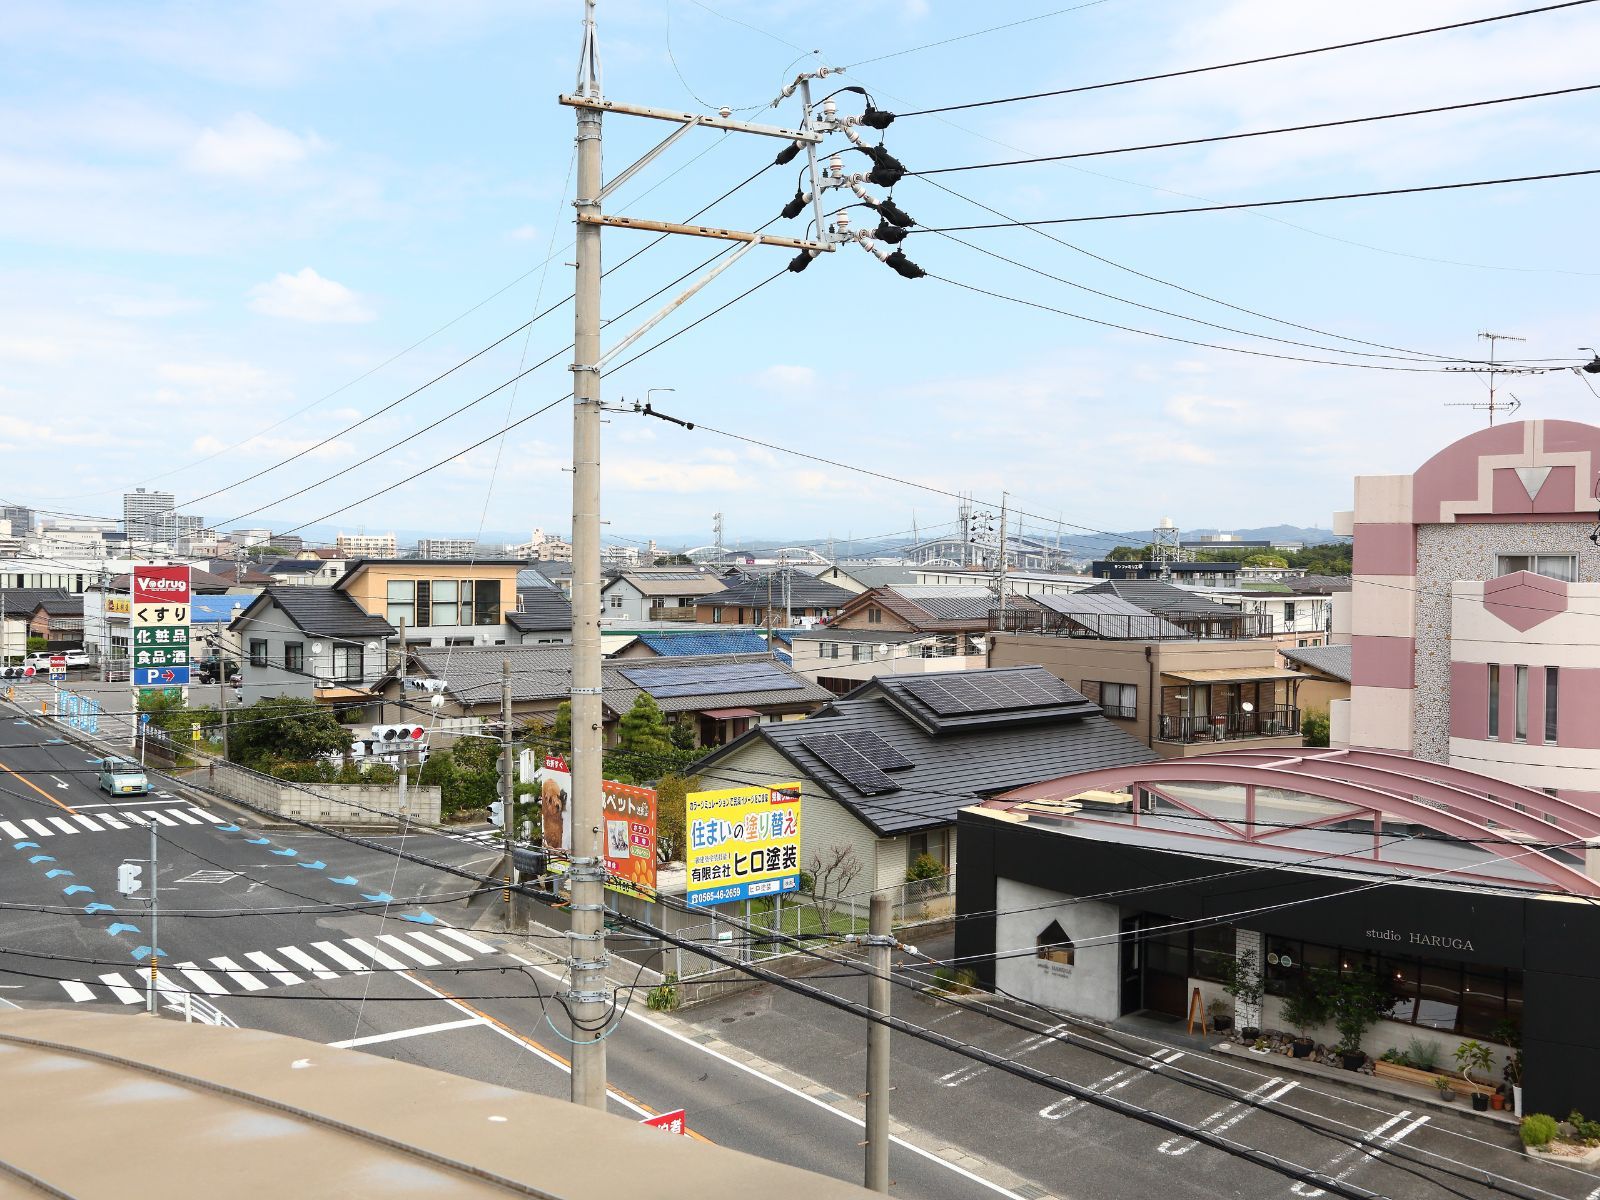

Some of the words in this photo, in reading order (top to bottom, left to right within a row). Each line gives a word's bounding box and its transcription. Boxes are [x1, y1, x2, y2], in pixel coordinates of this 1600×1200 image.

[137, 606, 186, 622] くすり
[136, 628, 187, 644] 化粧品
[136, 649, 187, 665] 食品・酒
[147, 669, 159, 684] P
[691, 809, 797, 849] 住まいの塗り替え
[691, 863, 731, 883] 有限会社
[734, 844, 797, 876] ヒロ塗装
[1366, 929, 1401, 941] studio
[1409, 932, 1475, 952] HARUGA
